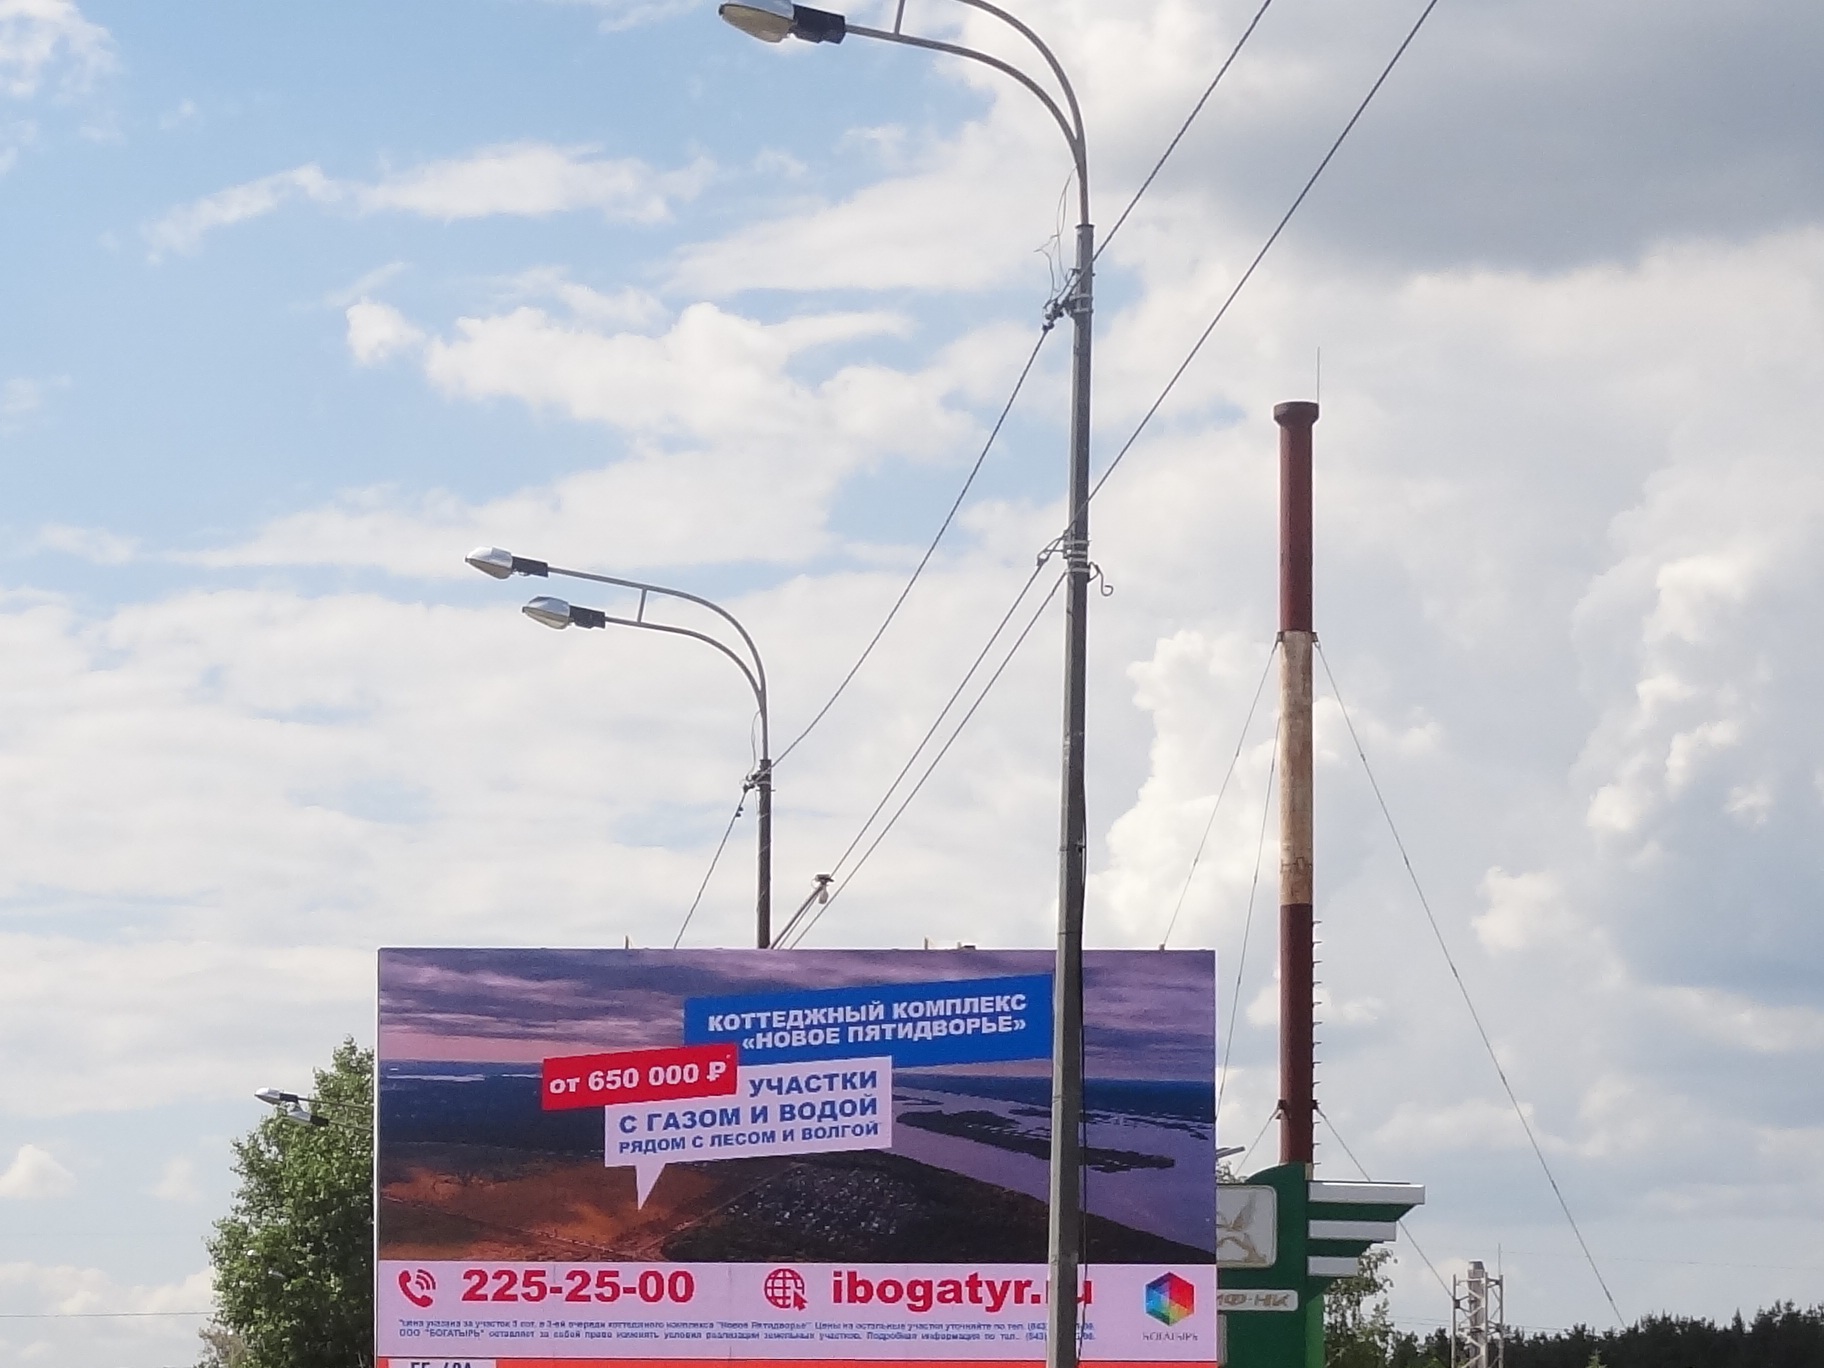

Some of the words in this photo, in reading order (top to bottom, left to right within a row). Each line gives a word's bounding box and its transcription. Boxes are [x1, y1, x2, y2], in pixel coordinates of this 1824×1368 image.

[708, 1001, 884, 1032] КОТТЕДЖНЫЙ
[892, 993, 1026, 1019] КОМПЛЕКС
[742, 1028, 840, 1050] «НОВОЕ
[848, 1015, 1025, 1044] ПЯТИДВОРЬЕ»
[549, 1076, 580, 1095] от
[587, 1068, 639, 1092] 650
[648, 1064, 699, 1087] 000
[749, 1070, 877, 1097] УЧАСТКИ
[619, 1115, 637, 1135] С
[647, 1107, 741, 1132] ГАЗОМ
[751, 1105, 769, 1124] И
[779, 1096, 877, 1123] ВОДОЙ
[619, 1134, 686, 1155] РЯДОМ
[691, 1132, 704, 1149] С
[709, 1129, 776, 1148] ЛЕСОМ
[783, 1126, 794, 1142] И
[801, 1121, 879, 1141] ВОЛГОЙ
[462, 1269, 695, 1304] 225-25-00
[831, 1270, 1093, 1312] ibogatyr.u
